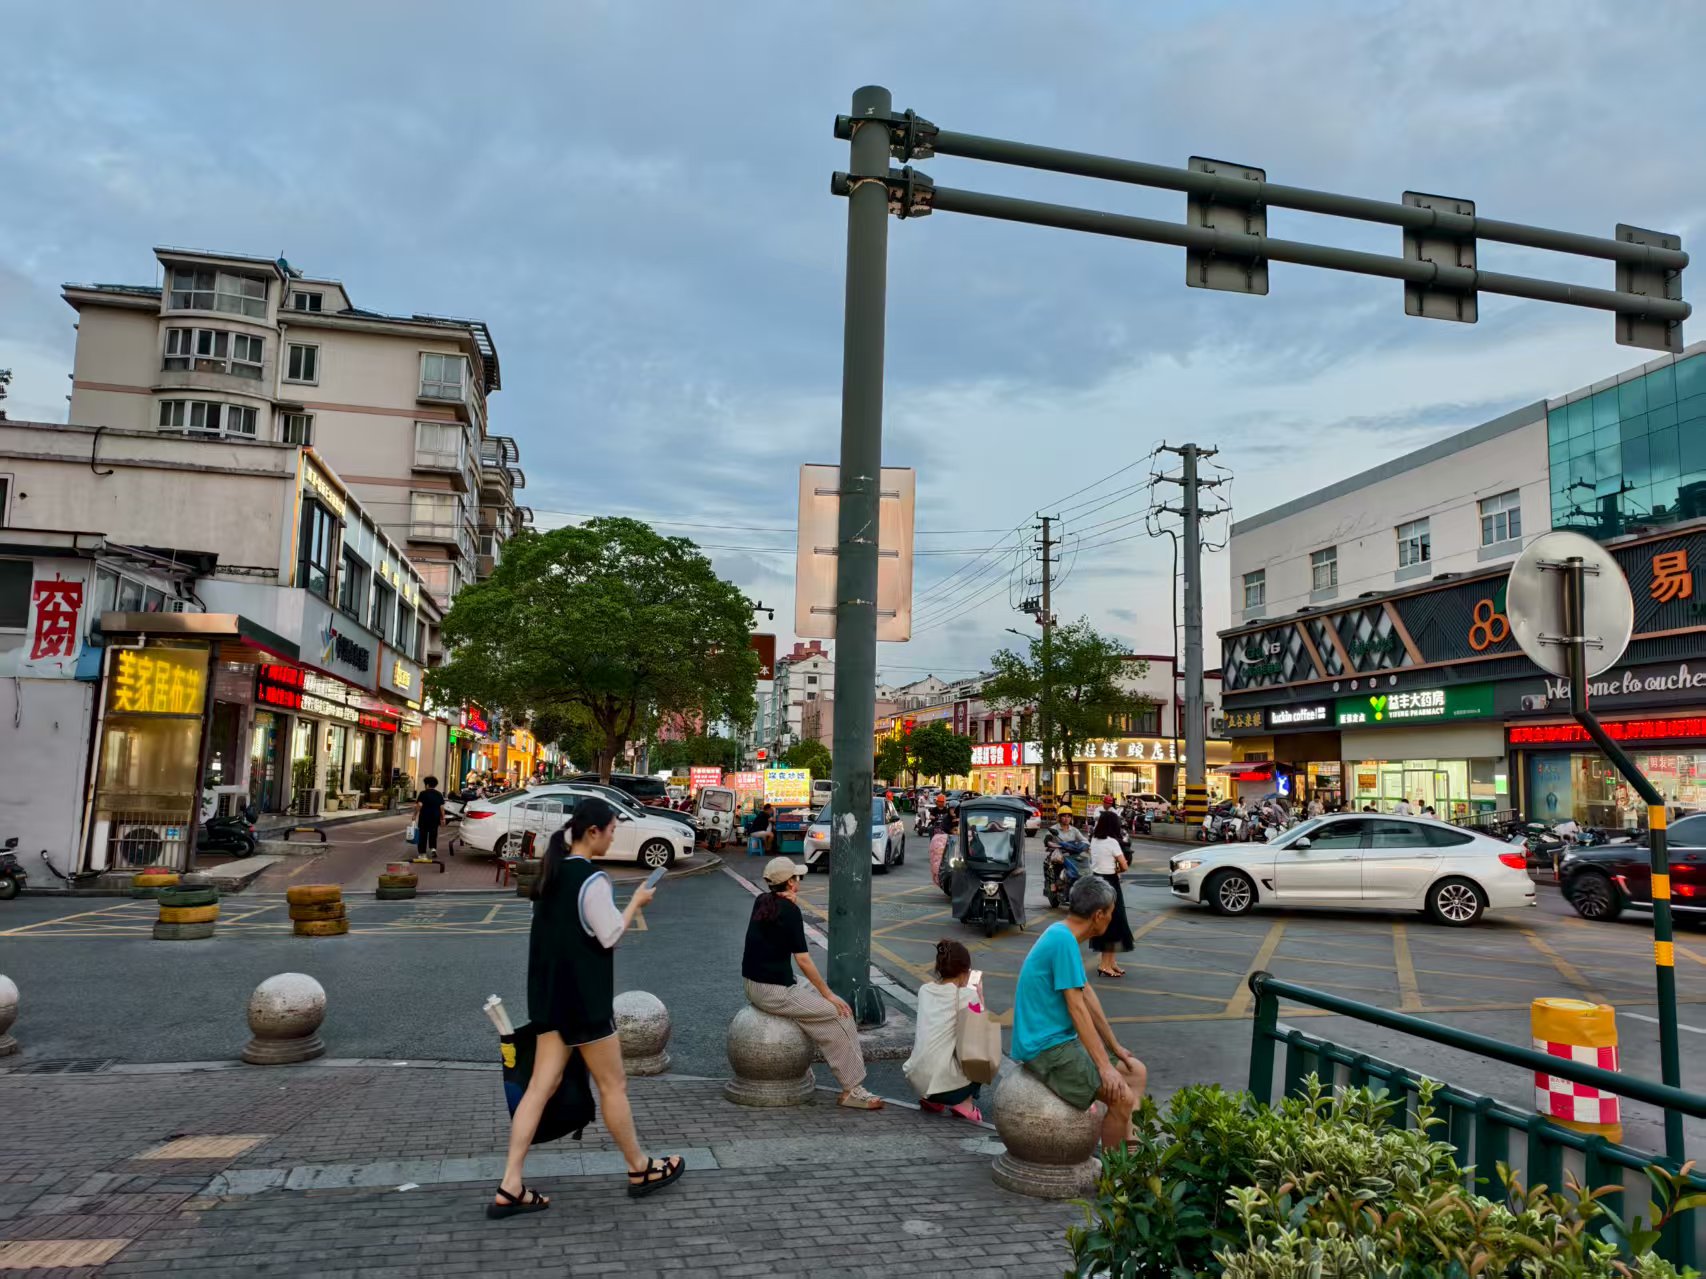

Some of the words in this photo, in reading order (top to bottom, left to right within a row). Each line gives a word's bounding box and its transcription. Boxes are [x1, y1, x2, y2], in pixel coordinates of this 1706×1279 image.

[1650, 549, 1693, 603] 易
[1545, 678, 1620, 700] Welome
[1622, 670, 1643, 694] to
[1388, 690, 1445, 711] 益丰大药房
[1271, 710, 1292, 725] luckin
[1293, 707, 1315, 723] coffee
[1388, 710, 1409, 719] YIFENG
[1410, 707, 1445, 717] PHARMACY
